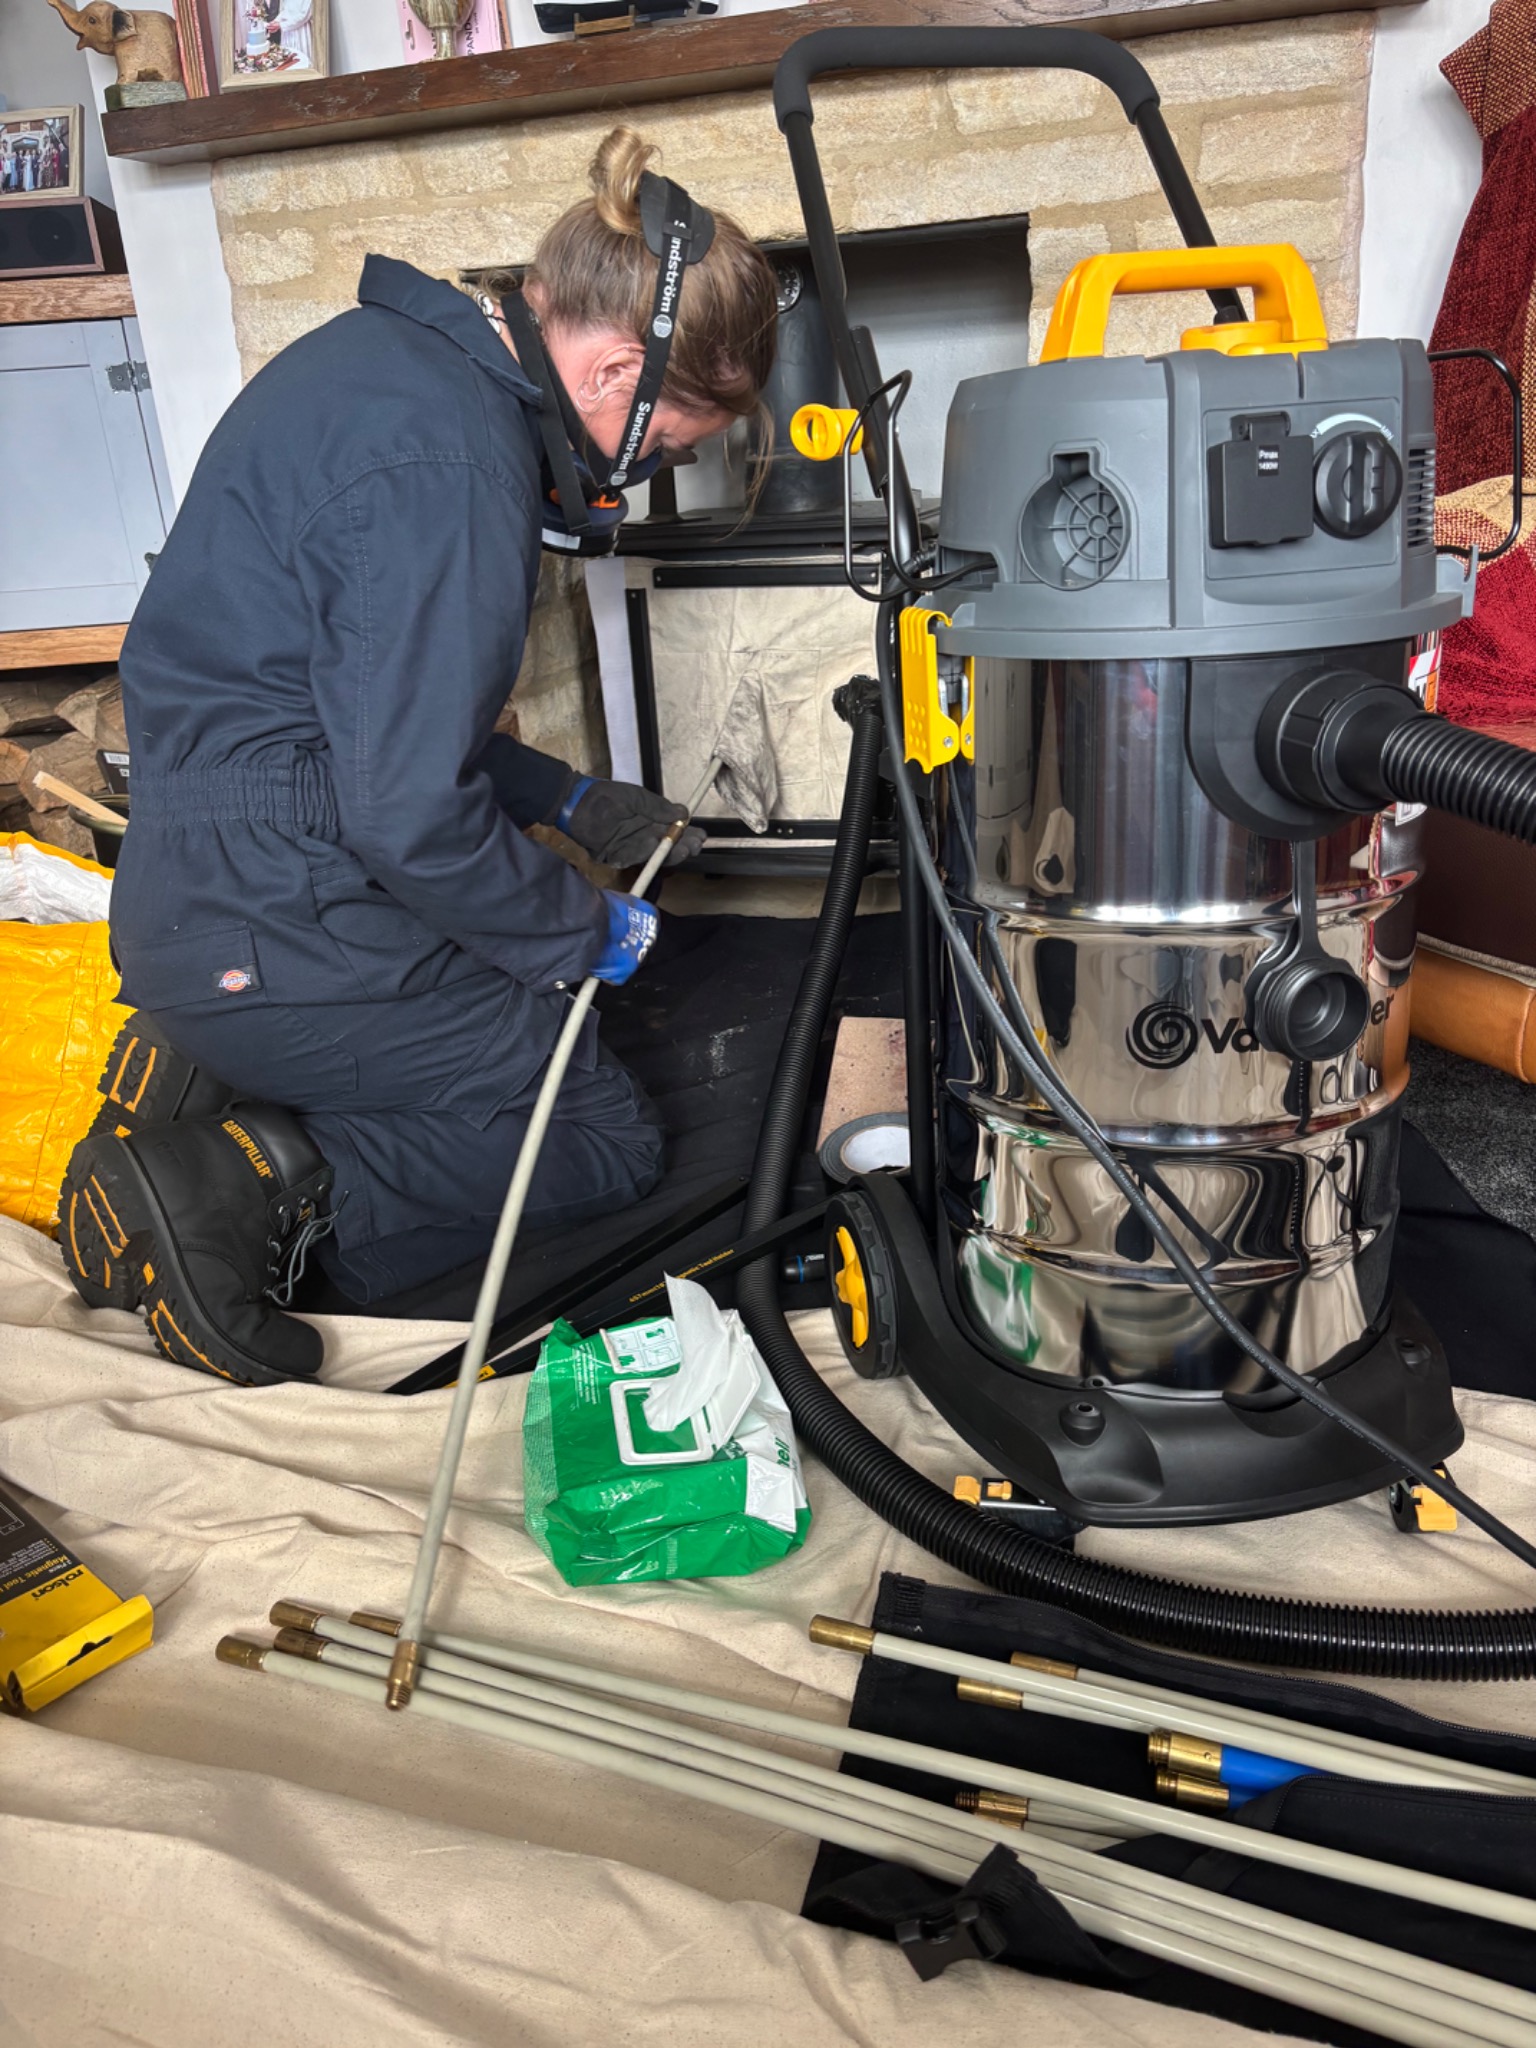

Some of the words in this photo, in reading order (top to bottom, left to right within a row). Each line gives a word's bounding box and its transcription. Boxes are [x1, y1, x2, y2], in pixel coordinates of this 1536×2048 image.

[660, 219, 686, 313] ndström
[618, 401, 651, 470] Sundström
[32, 1569, 84, 1599] rolson
